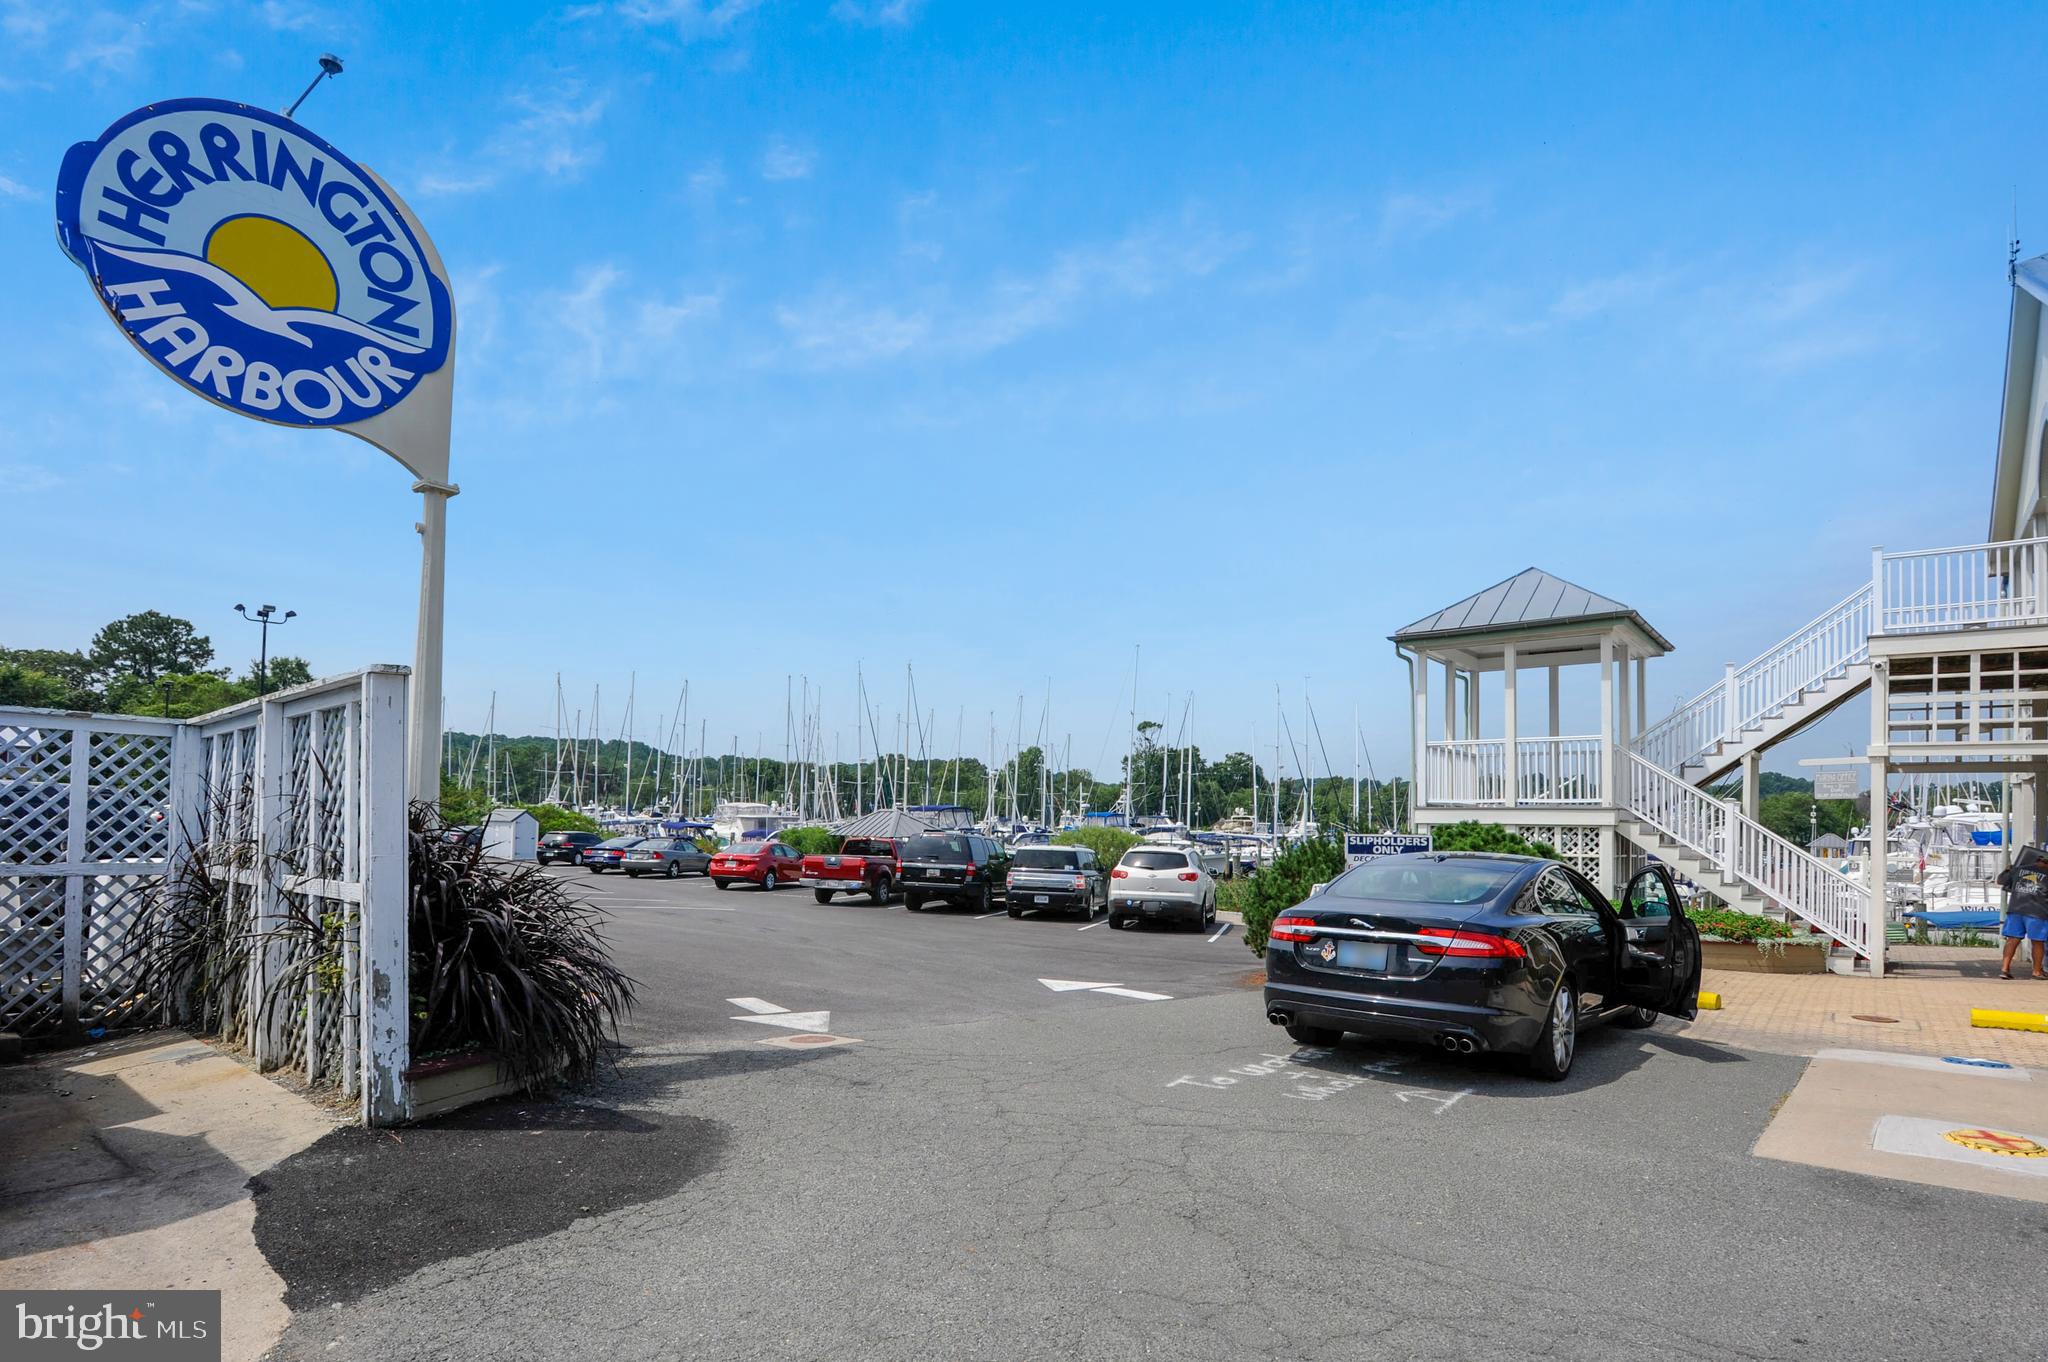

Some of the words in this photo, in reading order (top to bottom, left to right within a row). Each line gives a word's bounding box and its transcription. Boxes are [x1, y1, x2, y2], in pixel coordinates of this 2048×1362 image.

[97, 122, 421, 339] HERRINGTON
[105, 279, 415, 419] HARBOUR
[1349, 836, 1428, 846] SLIPHOLDERS
[1372, 846, 1403, 854] ONLY
